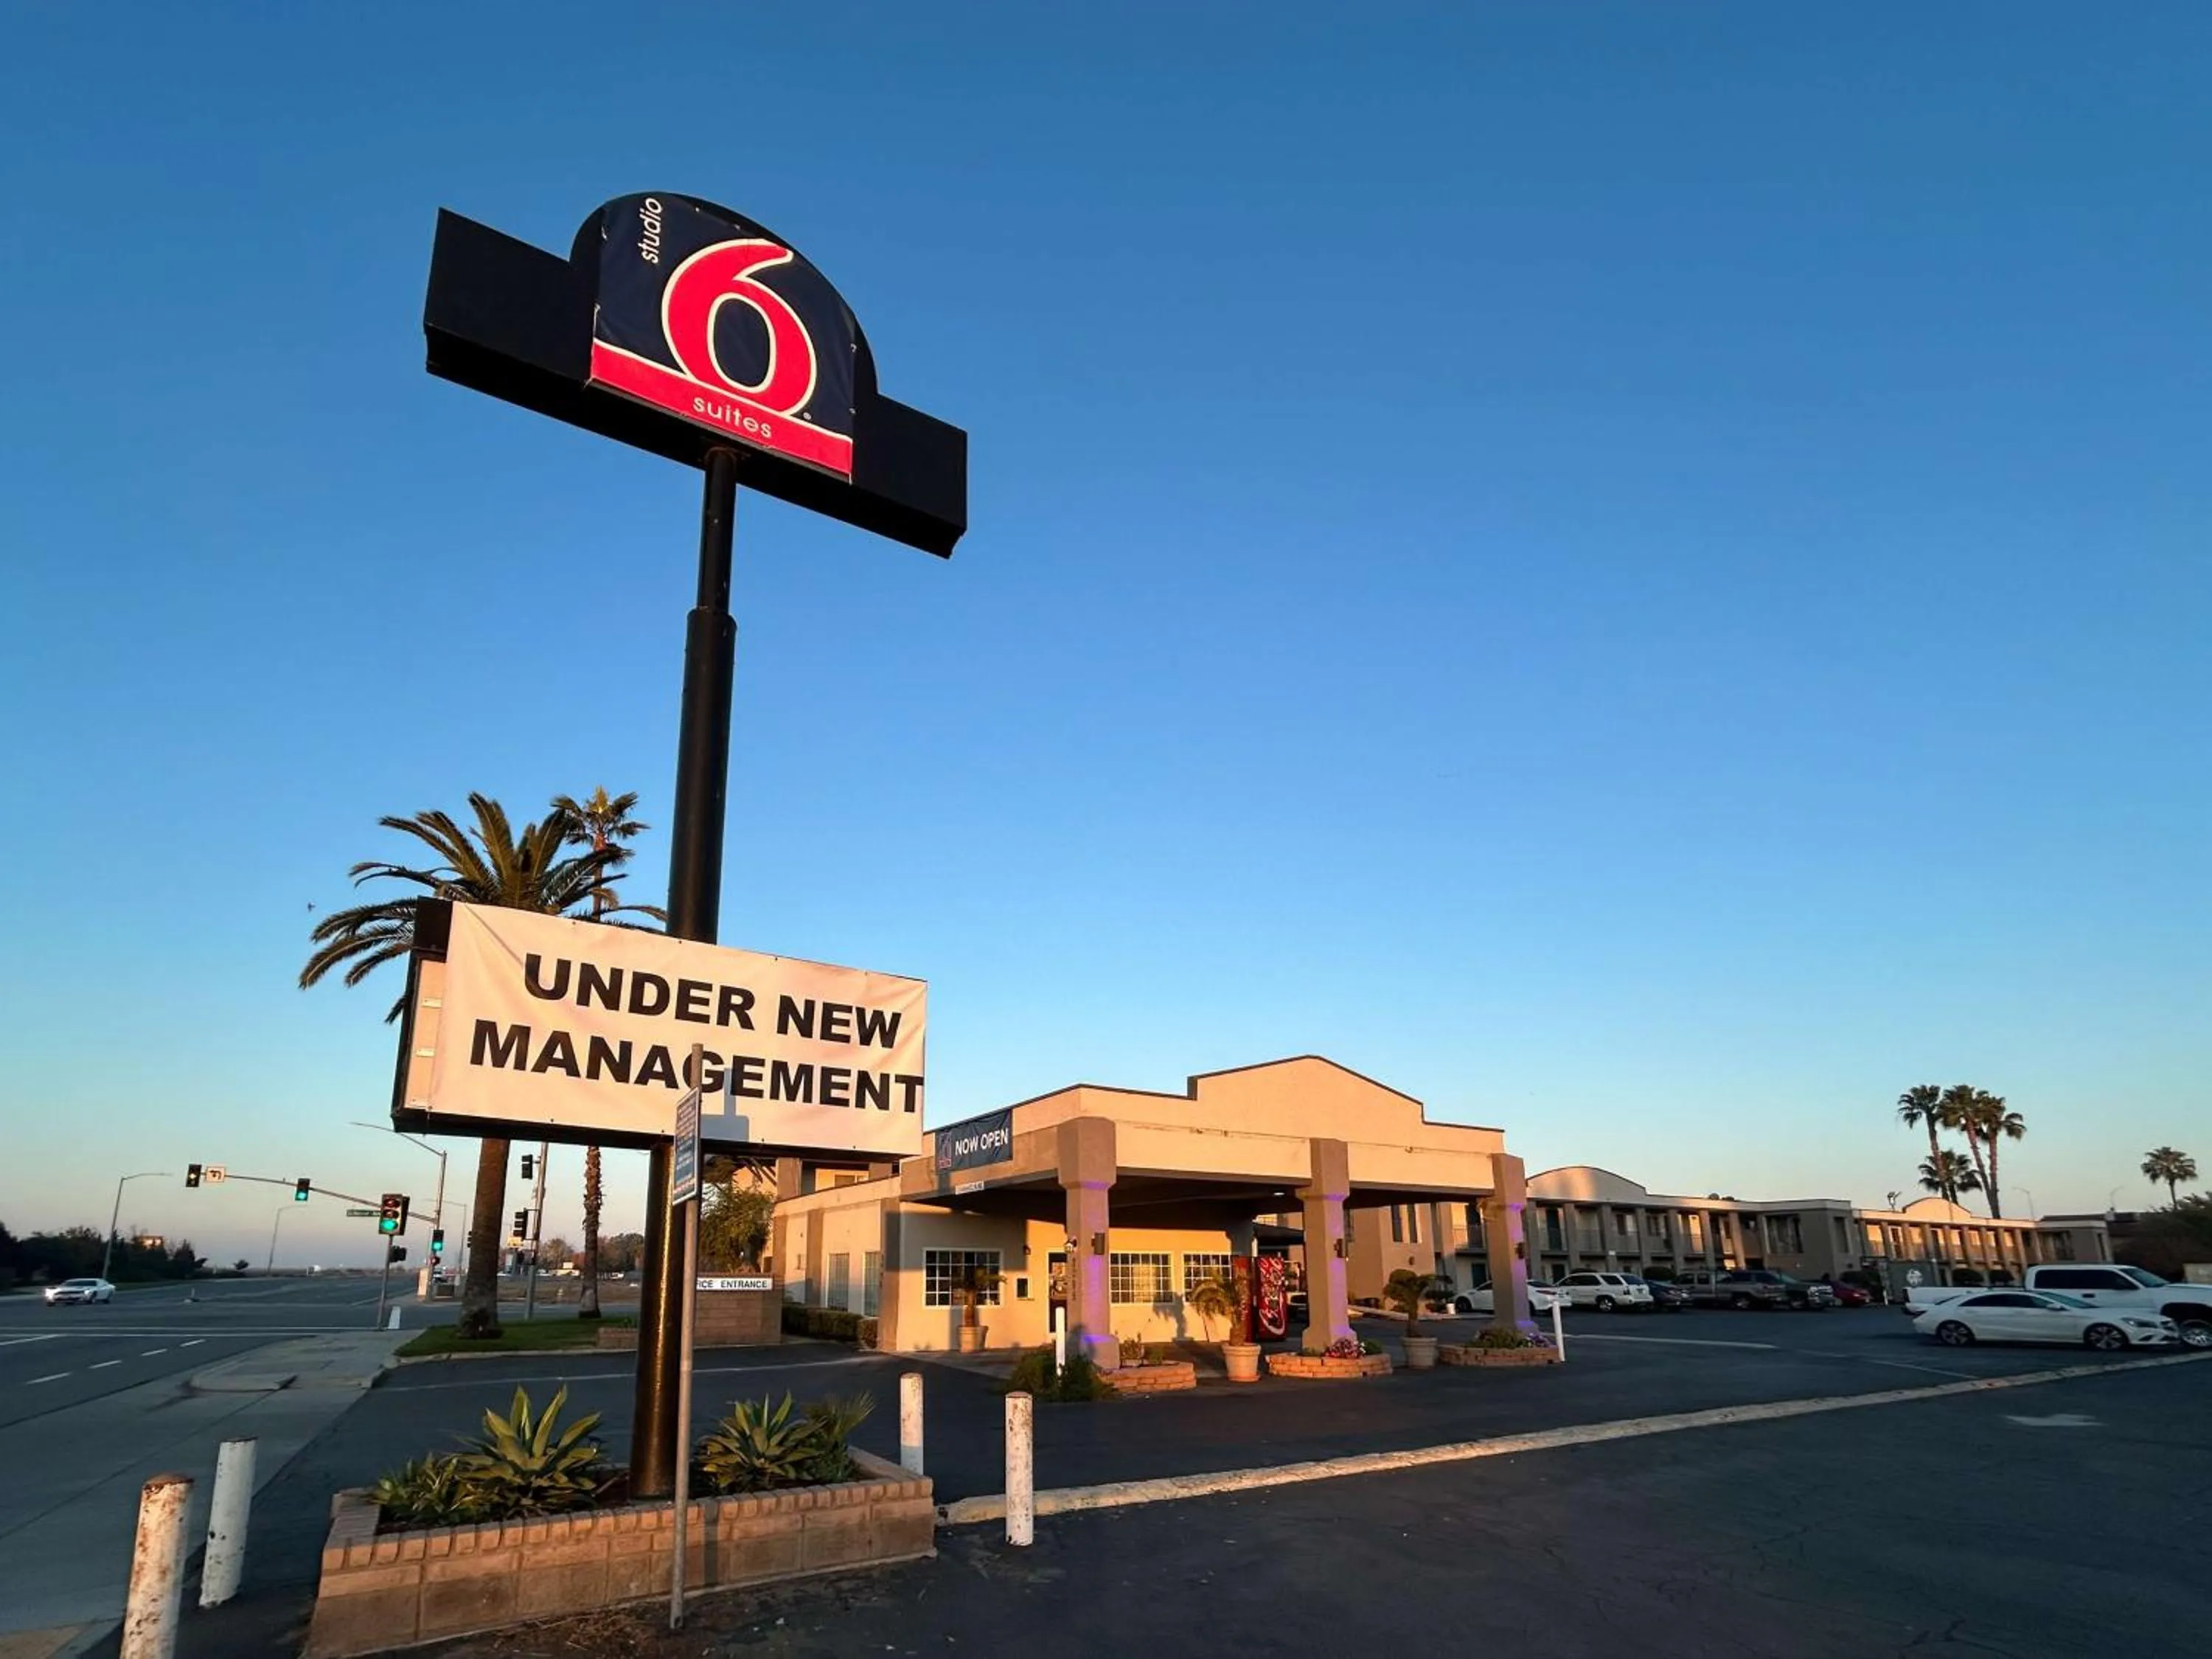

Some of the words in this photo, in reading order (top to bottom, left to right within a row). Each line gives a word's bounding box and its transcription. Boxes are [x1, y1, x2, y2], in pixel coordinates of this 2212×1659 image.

[638, 198, 664, 264] studio
[661, 238, 817, 416] 6
[692, 396, 772, 438] suites
[524, 953, 756, 1031] UNDER
[776, 994, 902, 1049] NEW
[469, 1018, 925, 1113] MANAGEMENT
[955, 1136, 978, 1155] NOW
[980, 1128, 1009, 1150] OPEN
[720, 1279, 768, 1288] ENTRANCE
